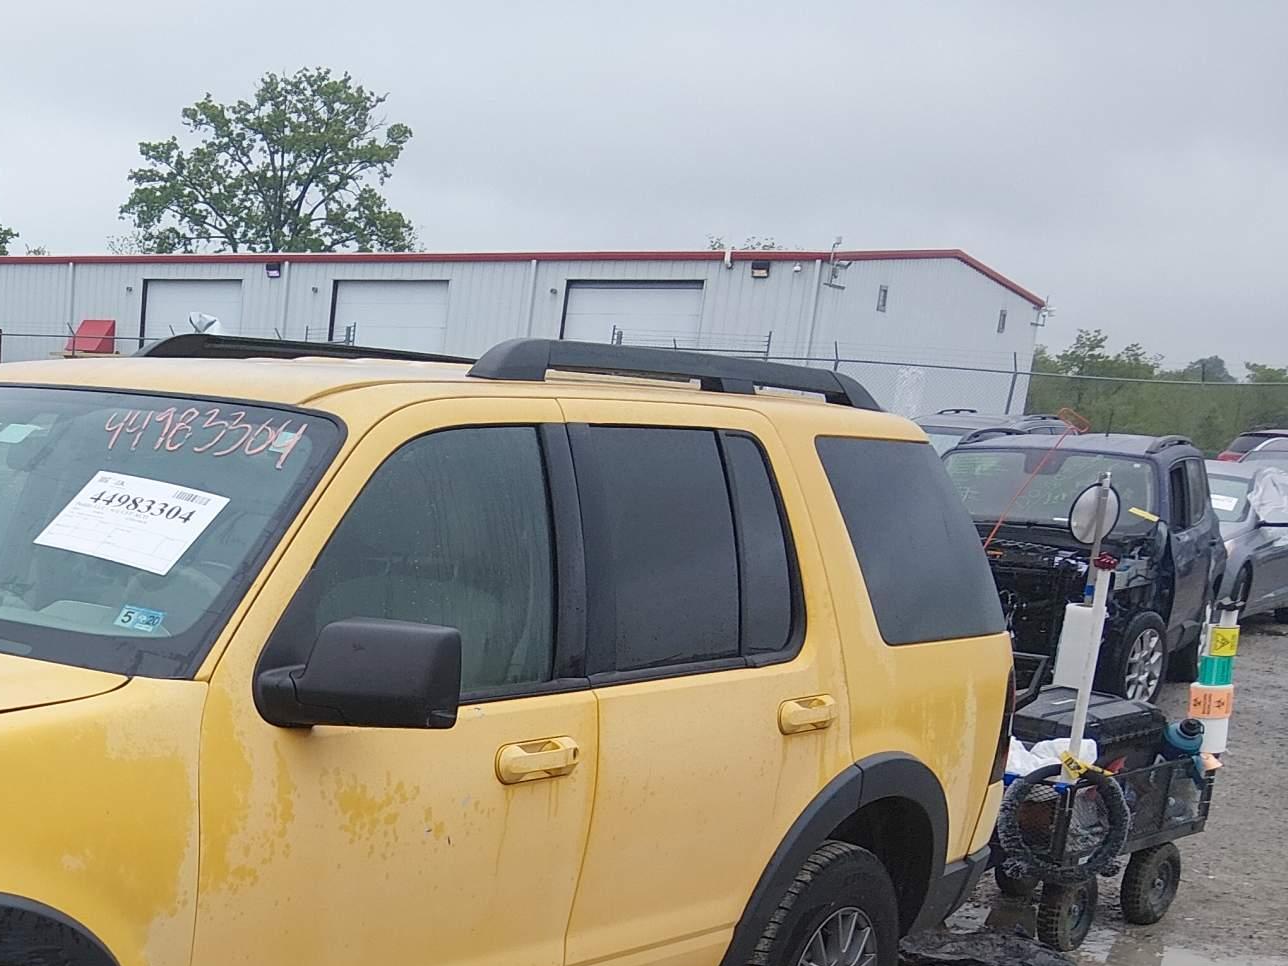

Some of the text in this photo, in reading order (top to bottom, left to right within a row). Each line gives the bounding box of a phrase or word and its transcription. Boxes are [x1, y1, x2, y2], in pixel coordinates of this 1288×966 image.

[105, 407, 308, 469] 44983304
[89, 490, 197, 524] 44983304
[120, 610, 136, 624] 5
